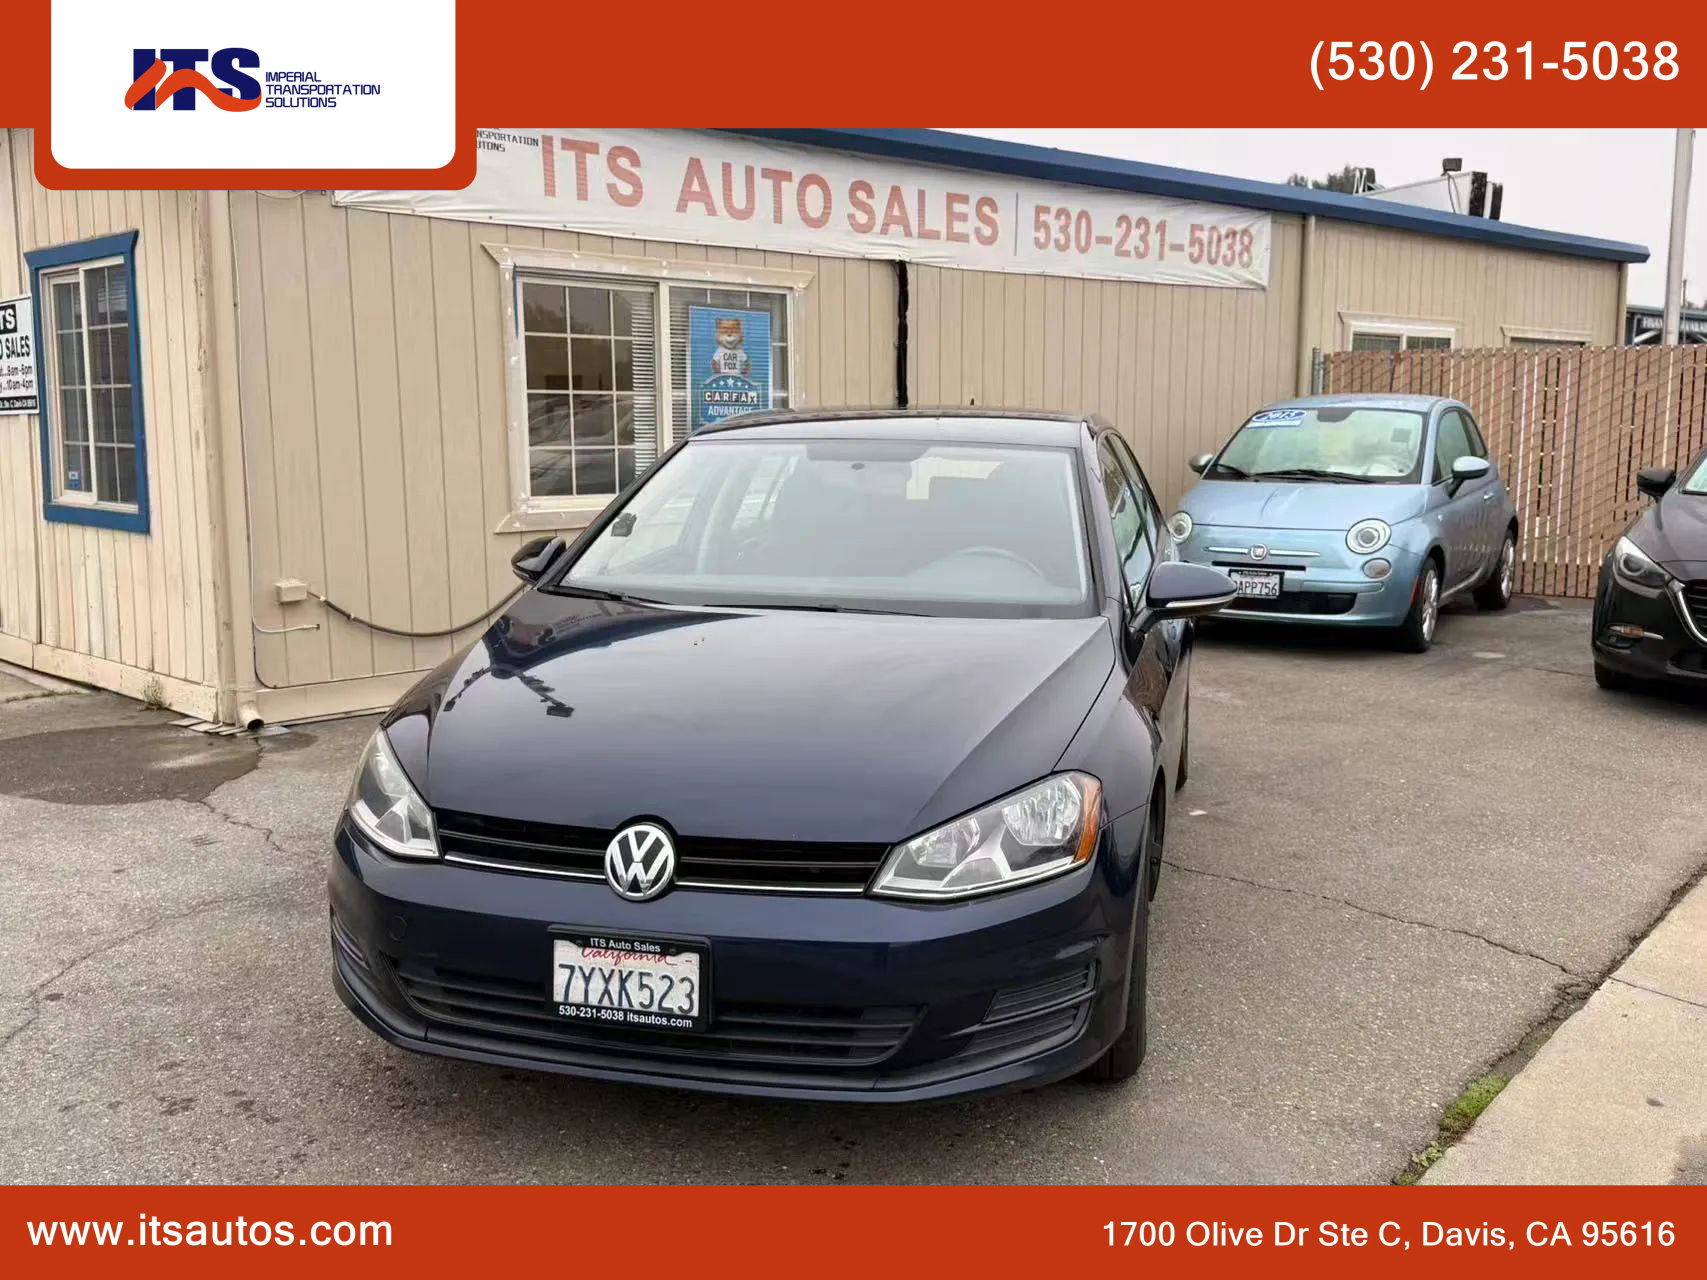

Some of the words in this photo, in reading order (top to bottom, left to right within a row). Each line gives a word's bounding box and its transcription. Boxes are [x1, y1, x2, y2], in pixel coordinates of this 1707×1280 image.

[541, 134, 645, 208] ITS
[675, 156, 833, 229] AUTO
[847, 180, 999, 246] SALES
[1033, 205, 1254, 269] 530-231-5038
[723, 353, 738, 361] CAR
[724, 362, 737, 370] FOX
[704, 391, 758, 404] CARFAX
[1234, 580, 1278, 596] APP756
[590, 937, 607, 947] ITS
[608, 940, 632, 950] Auto
[633, 942, 661, 953] Sales
[558, 963, 695, 1015] 7YXK523
[558, 1004, 625, 1021] 530-231-5038
[626, 1011, 693, 1028] itsautos.com
